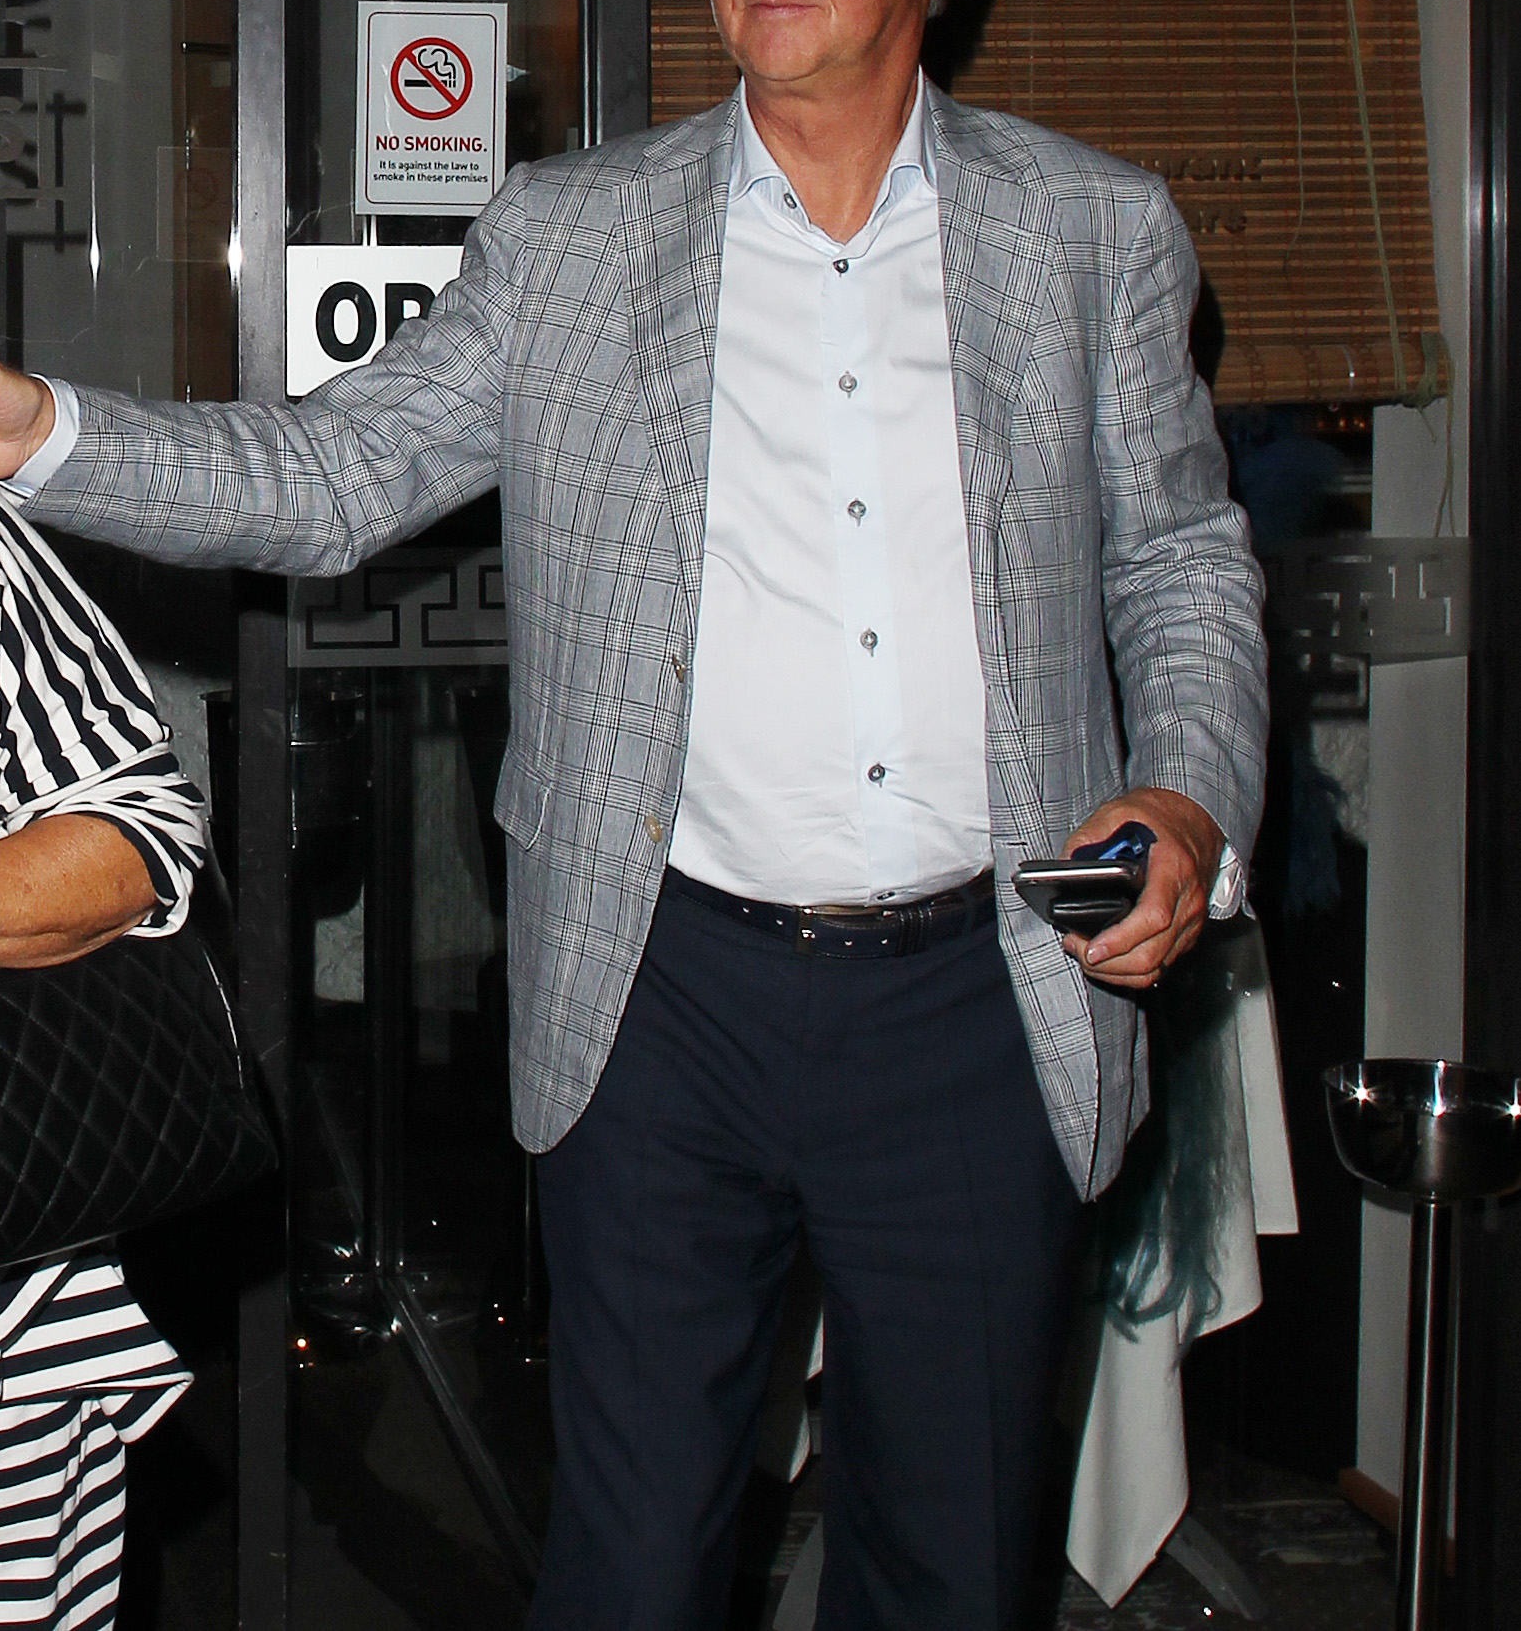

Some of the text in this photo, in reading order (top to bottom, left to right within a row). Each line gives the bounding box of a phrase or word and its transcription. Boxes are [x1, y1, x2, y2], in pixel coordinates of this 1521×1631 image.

[375, 135, 488, 153] NO SMOKING.
[379, 160, 480, 172] It is against the law to
[373, 171, 489, 184] smoke in these premises
